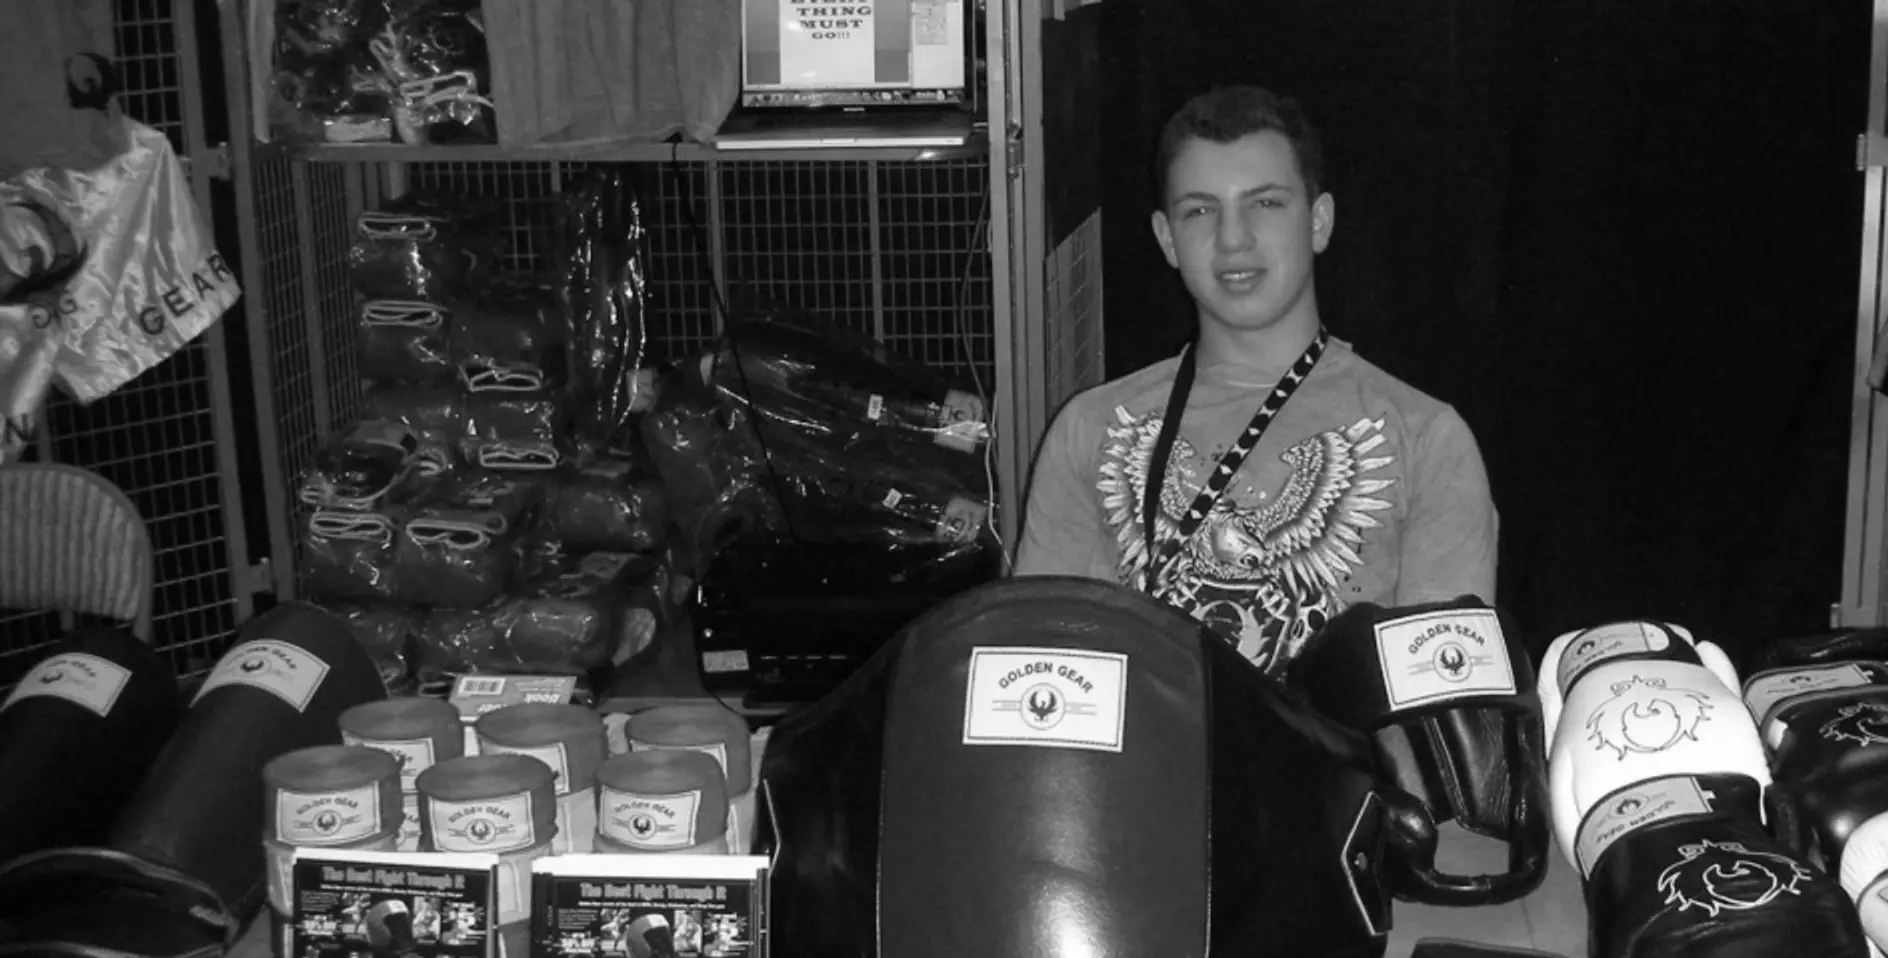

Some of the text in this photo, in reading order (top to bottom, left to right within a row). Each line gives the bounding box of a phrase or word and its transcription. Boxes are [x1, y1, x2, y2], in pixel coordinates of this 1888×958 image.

[796, 6, 872, 17] THING
[799, 19, 863, 29] MUST
[139, 253, 231, 336] GEAR
[1407, 623, 1486, 654] GOLDEN GEAR
[998, 661, 1094, 693] GOLDEN GEAR
[296, 798, 332, 815] GOLDEN
[448, 805, 511, 823] GOLDEN GEAR
[614, 800, 650, 814] GOLDEN
